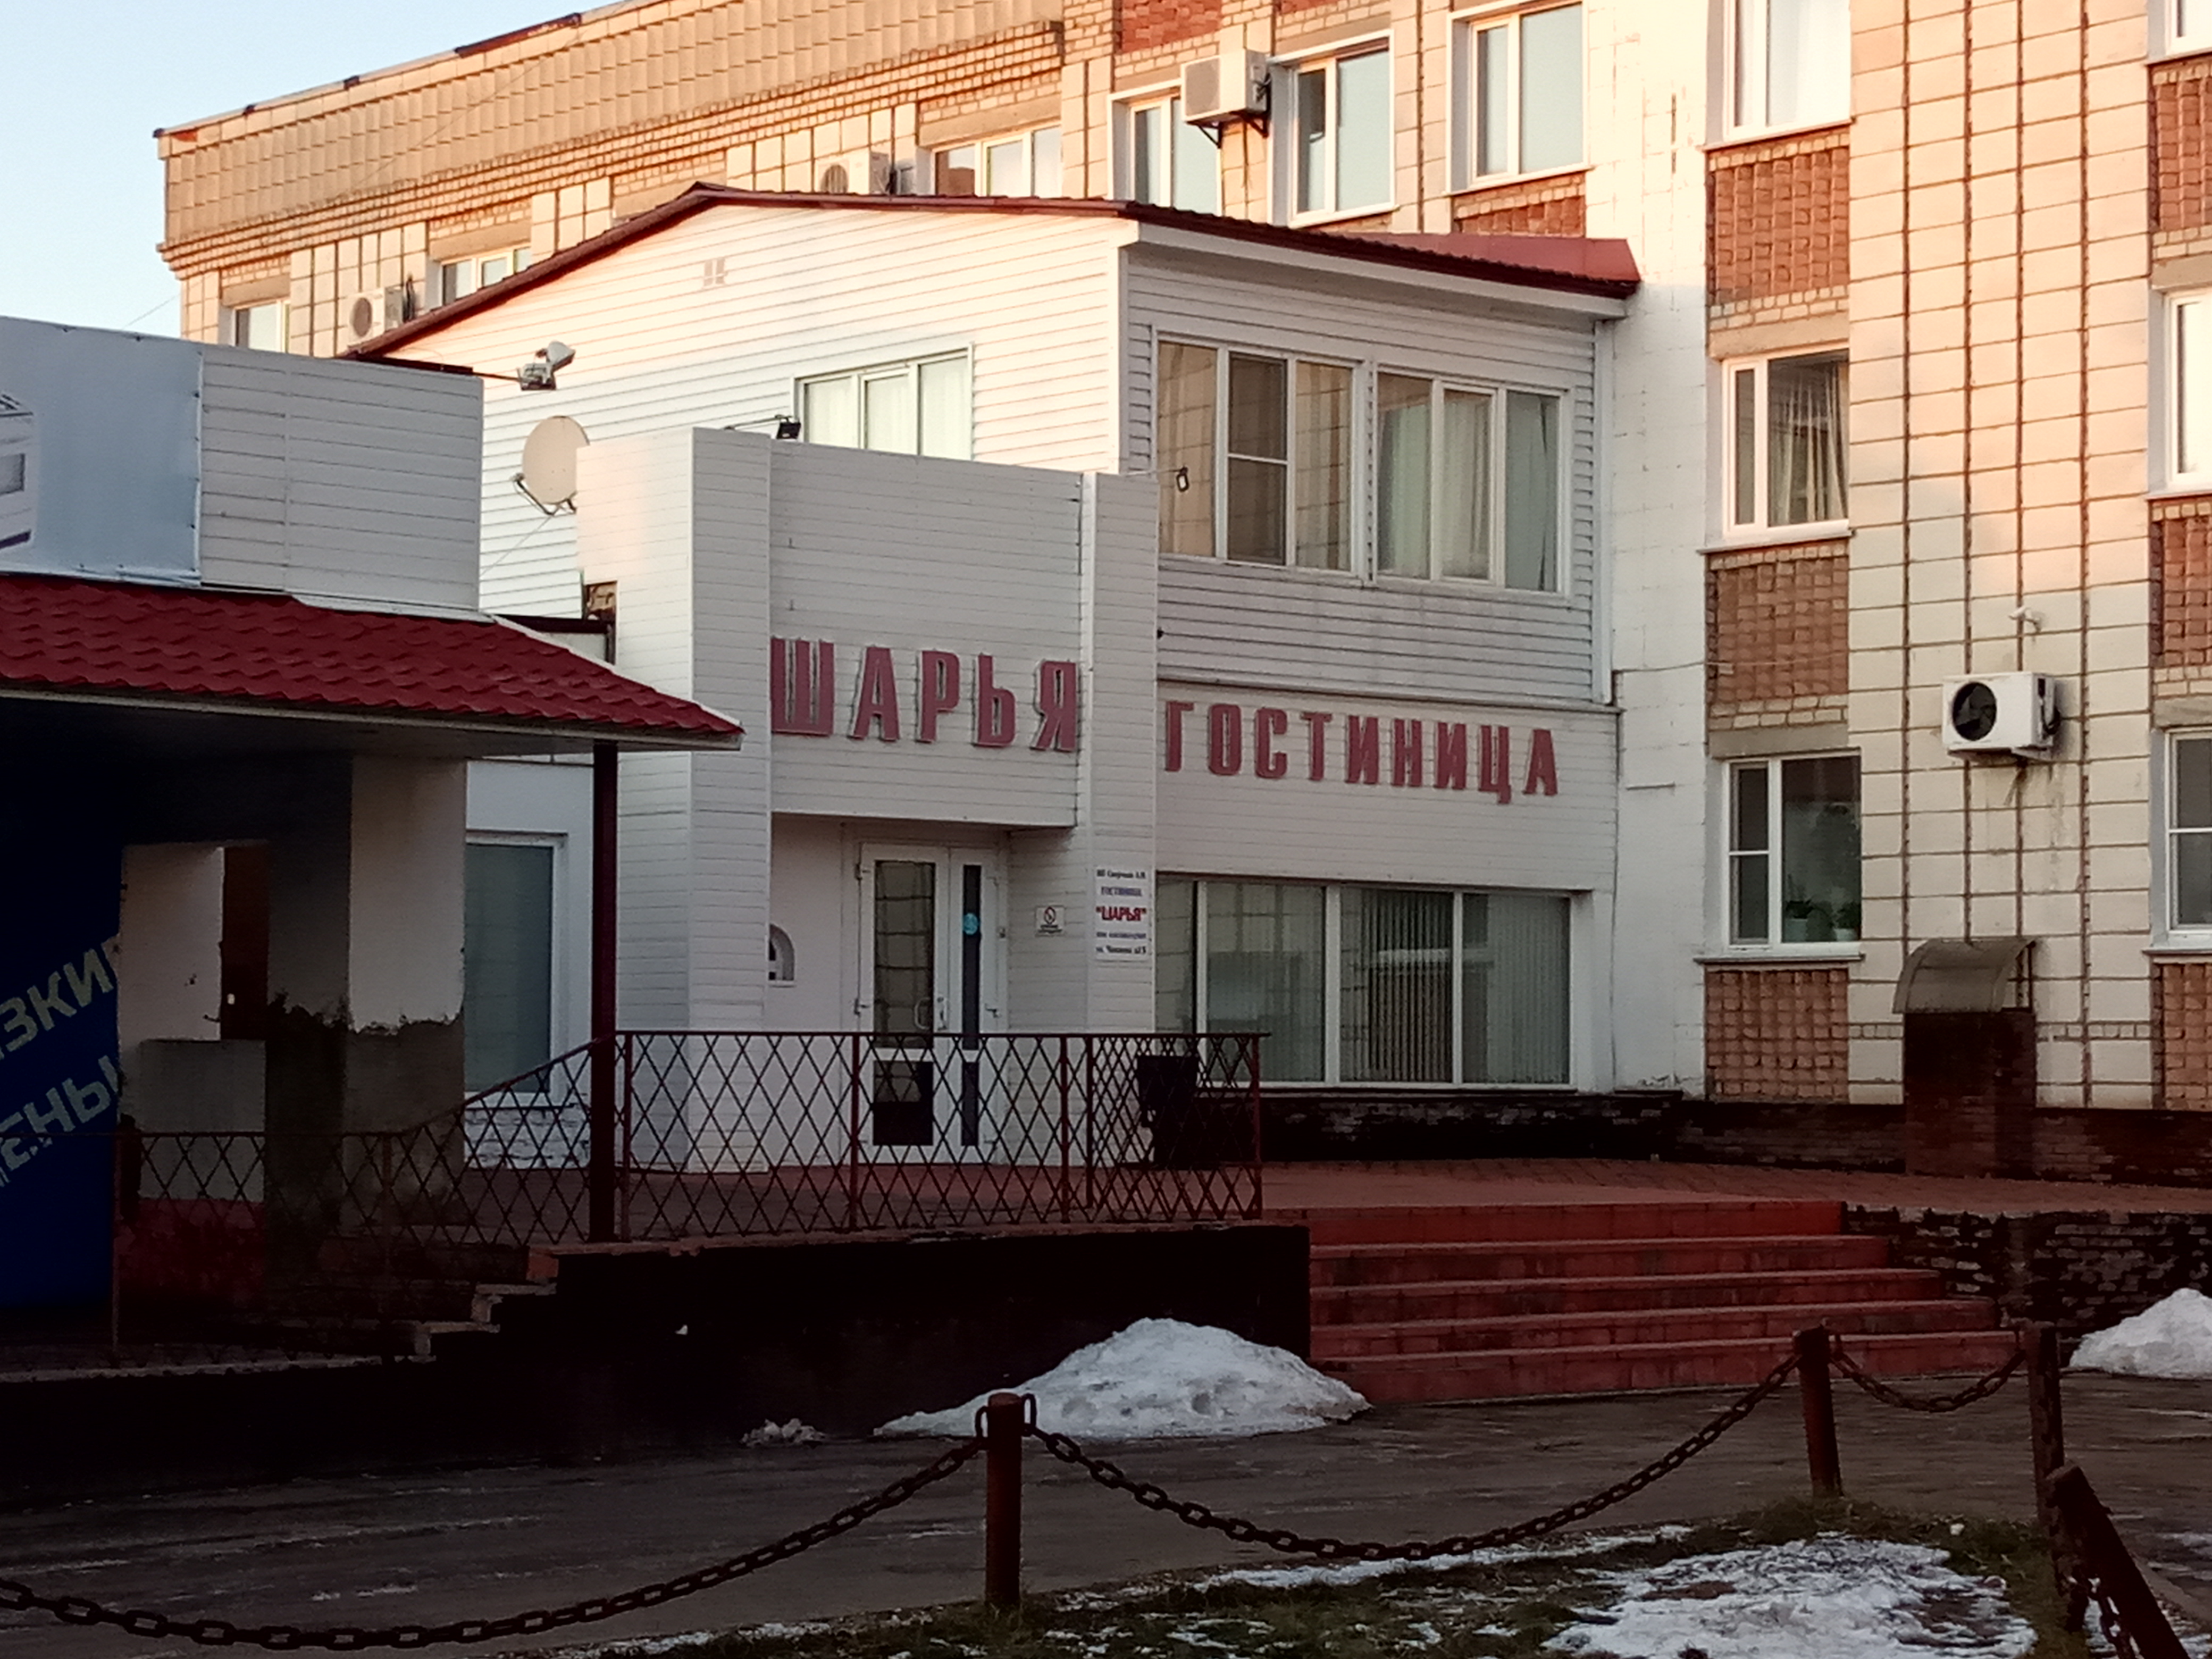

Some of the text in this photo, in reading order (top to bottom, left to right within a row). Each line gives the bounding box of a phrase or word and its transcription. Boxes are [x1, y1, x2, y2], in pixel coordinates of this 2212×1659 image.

[770, 635, 1079, 753] ШАРЬЯ
[1164, 700, 1559, 805] ГОСТИНИЦА
[0, 1055, 118, 1187] ЕНЫ
